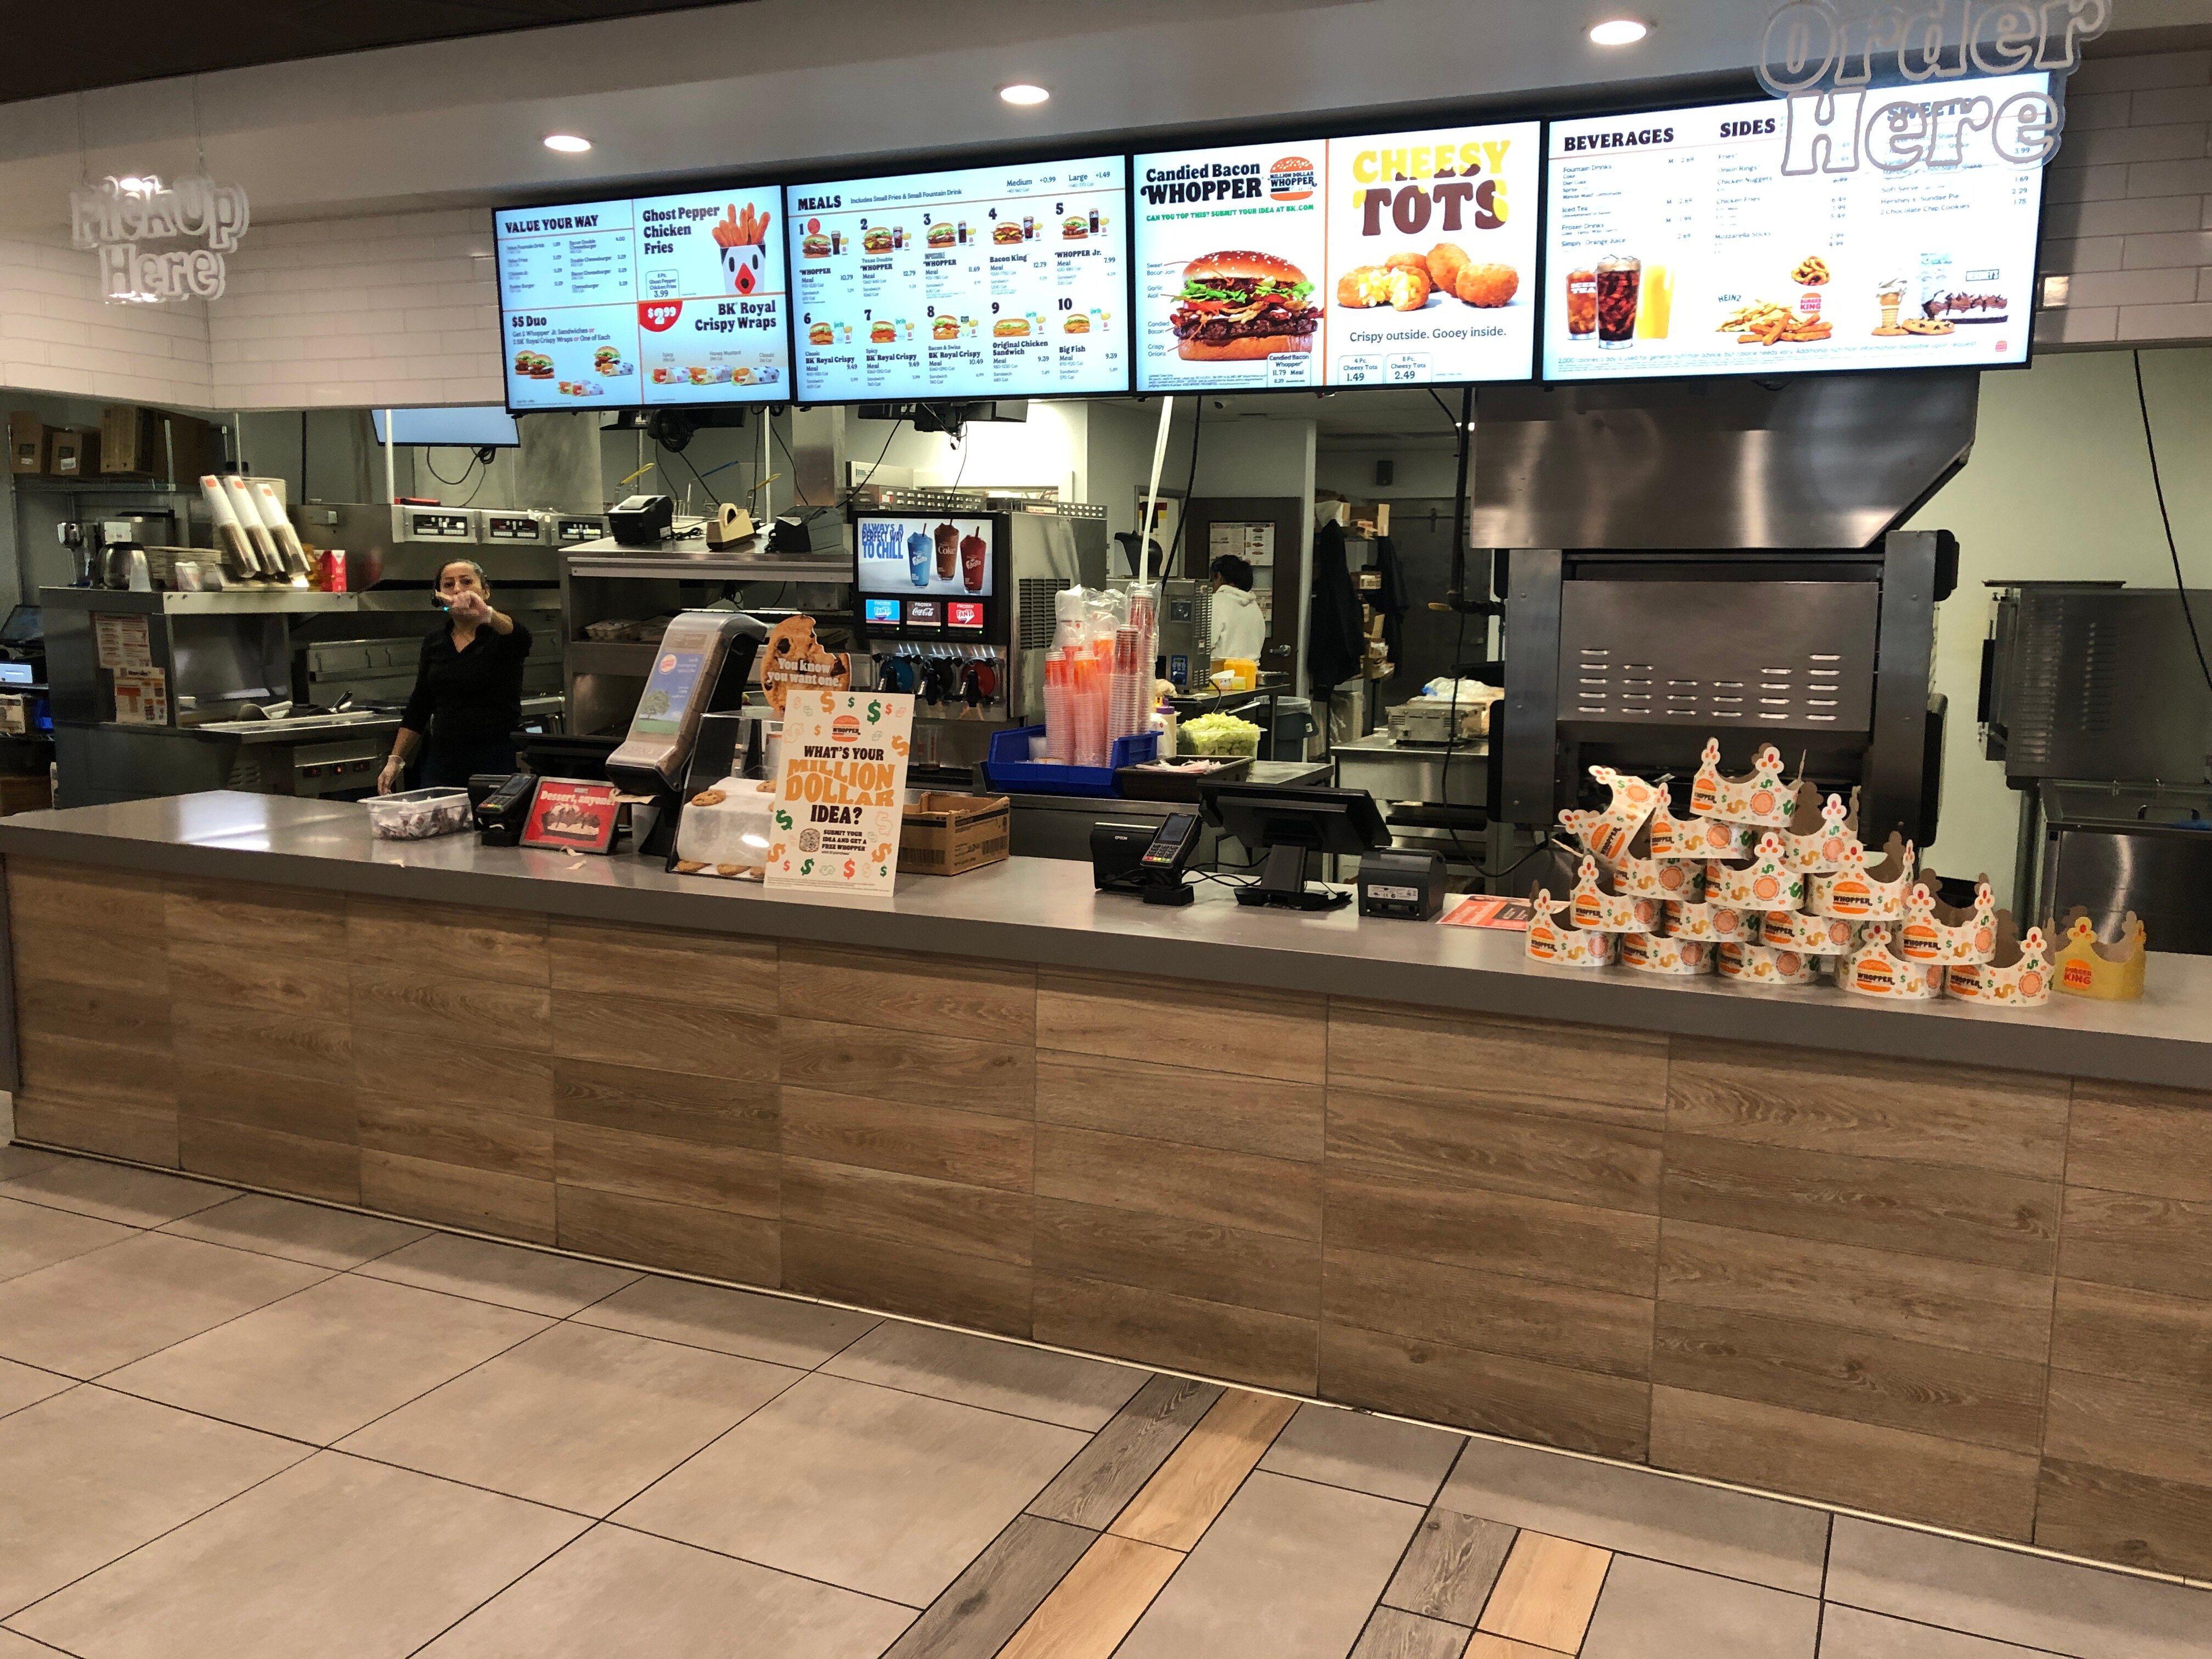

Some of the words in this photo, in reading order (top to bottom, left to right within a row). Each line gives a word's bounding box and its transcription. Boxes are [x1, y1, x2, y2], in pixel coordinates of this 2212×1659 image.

[1760, 0, 2106, 91] Order
[1720, 118, 1776, 138] SIDES
[1782, 87, 2058, 176] Here
[1564, 128, 1674, 151] BEVERAGES
[1353, 140, 1510, 183] CHEESY
[1146, 163, 1209, 182] Candied
[1212, 163, 1260, 177] Bacon
[1271, 177, 1317, 187] WHOPPER
[1140, 177, 1262, 205] WHOPPER
[798, 195, 841, 210] MEALS
[1056, 202, 1064, 215] 5
[1353, 179, 1509, 236] TOTS
[643, 209, 675, 221] Ghost
[678, 206, 720, 221] Pepper
[923, 213, 930, 225] 3
[989, 207, 997, 219] 4
[506, 218, 540, 233] VALUE
[542, 217, 572, 230] YOUR
[575, 215, 599, 228] WAY
[799, 224, 804, 235] 1
[860, 218, 867, 230] 2
[644, 224, 691, 238] Chicken
[644, 242, 673, 254] Fries
[1011, 254, 1027, 262] King
[99, 244, 225, 300] Here
[741, 300, 775, 316] Royal
[991, 302, 1000, 314] 9
[1058, 298, 1072, 311] 10
[864, 309, 871, 320] 7
[927, 306, 934, 317] 8
[512, 315, 524, 328] $5
[526, 315, 547, 326] Duo
[695, 317, 735, 332] Crispy
[738, 317, 776, 330] Wraps
[804, 313, 811, 324] 6
[1350, 330, 1383, 343] Crispy
[1387, 330, 1429, 341] outside.
[1433, 328, 1468, 339] Gooey
[1470, 326, 1506, 337] inside.
[992, 341, 1019, 349] Original
[1059, 346, 1070, 354] Big
[1347, 373, 1364, 381] 1.49
[1395, 371, 1415, 380] 2.49
[862, 523, 894, 532] ALWAYS
[862, 531, 889, 542] PERFECT
[890, 532, 904, 543] WAY
[862, 542, 874, 558] TO
[877, 542, 904, 558] CHILL
[938, 546, 956, 555] Coke
[778, 658, 798, 670] You
[800, 659, 830, 673] know
[768, 672, 788, 682] you
[790, 674, 816, 684] want
[819, 676, 842, 687] one.
[833, 727, 861, 735] WHOPPER
[804, 746, 849, 759] WHAT'S
[853, 748, 884, 760] YOUR
[787, 759, 895, 791] MILLION
[785, 773, 895, 807] DOLLAR
[540, 791, 577, 804] Dessert,
[811, 805, 862, 824] IDEA?
[1833, 895, 1872, 906] WHOPPER
[1904, 939, 1940, 950] WHOPPER
[2065, 967, 2091, 976] BURGER
[1858, 973, 1895, 985] WHOPPER
[1951, 974, 1982, 989] WHOPPER
[2064, 973, 2091, 984] KING
